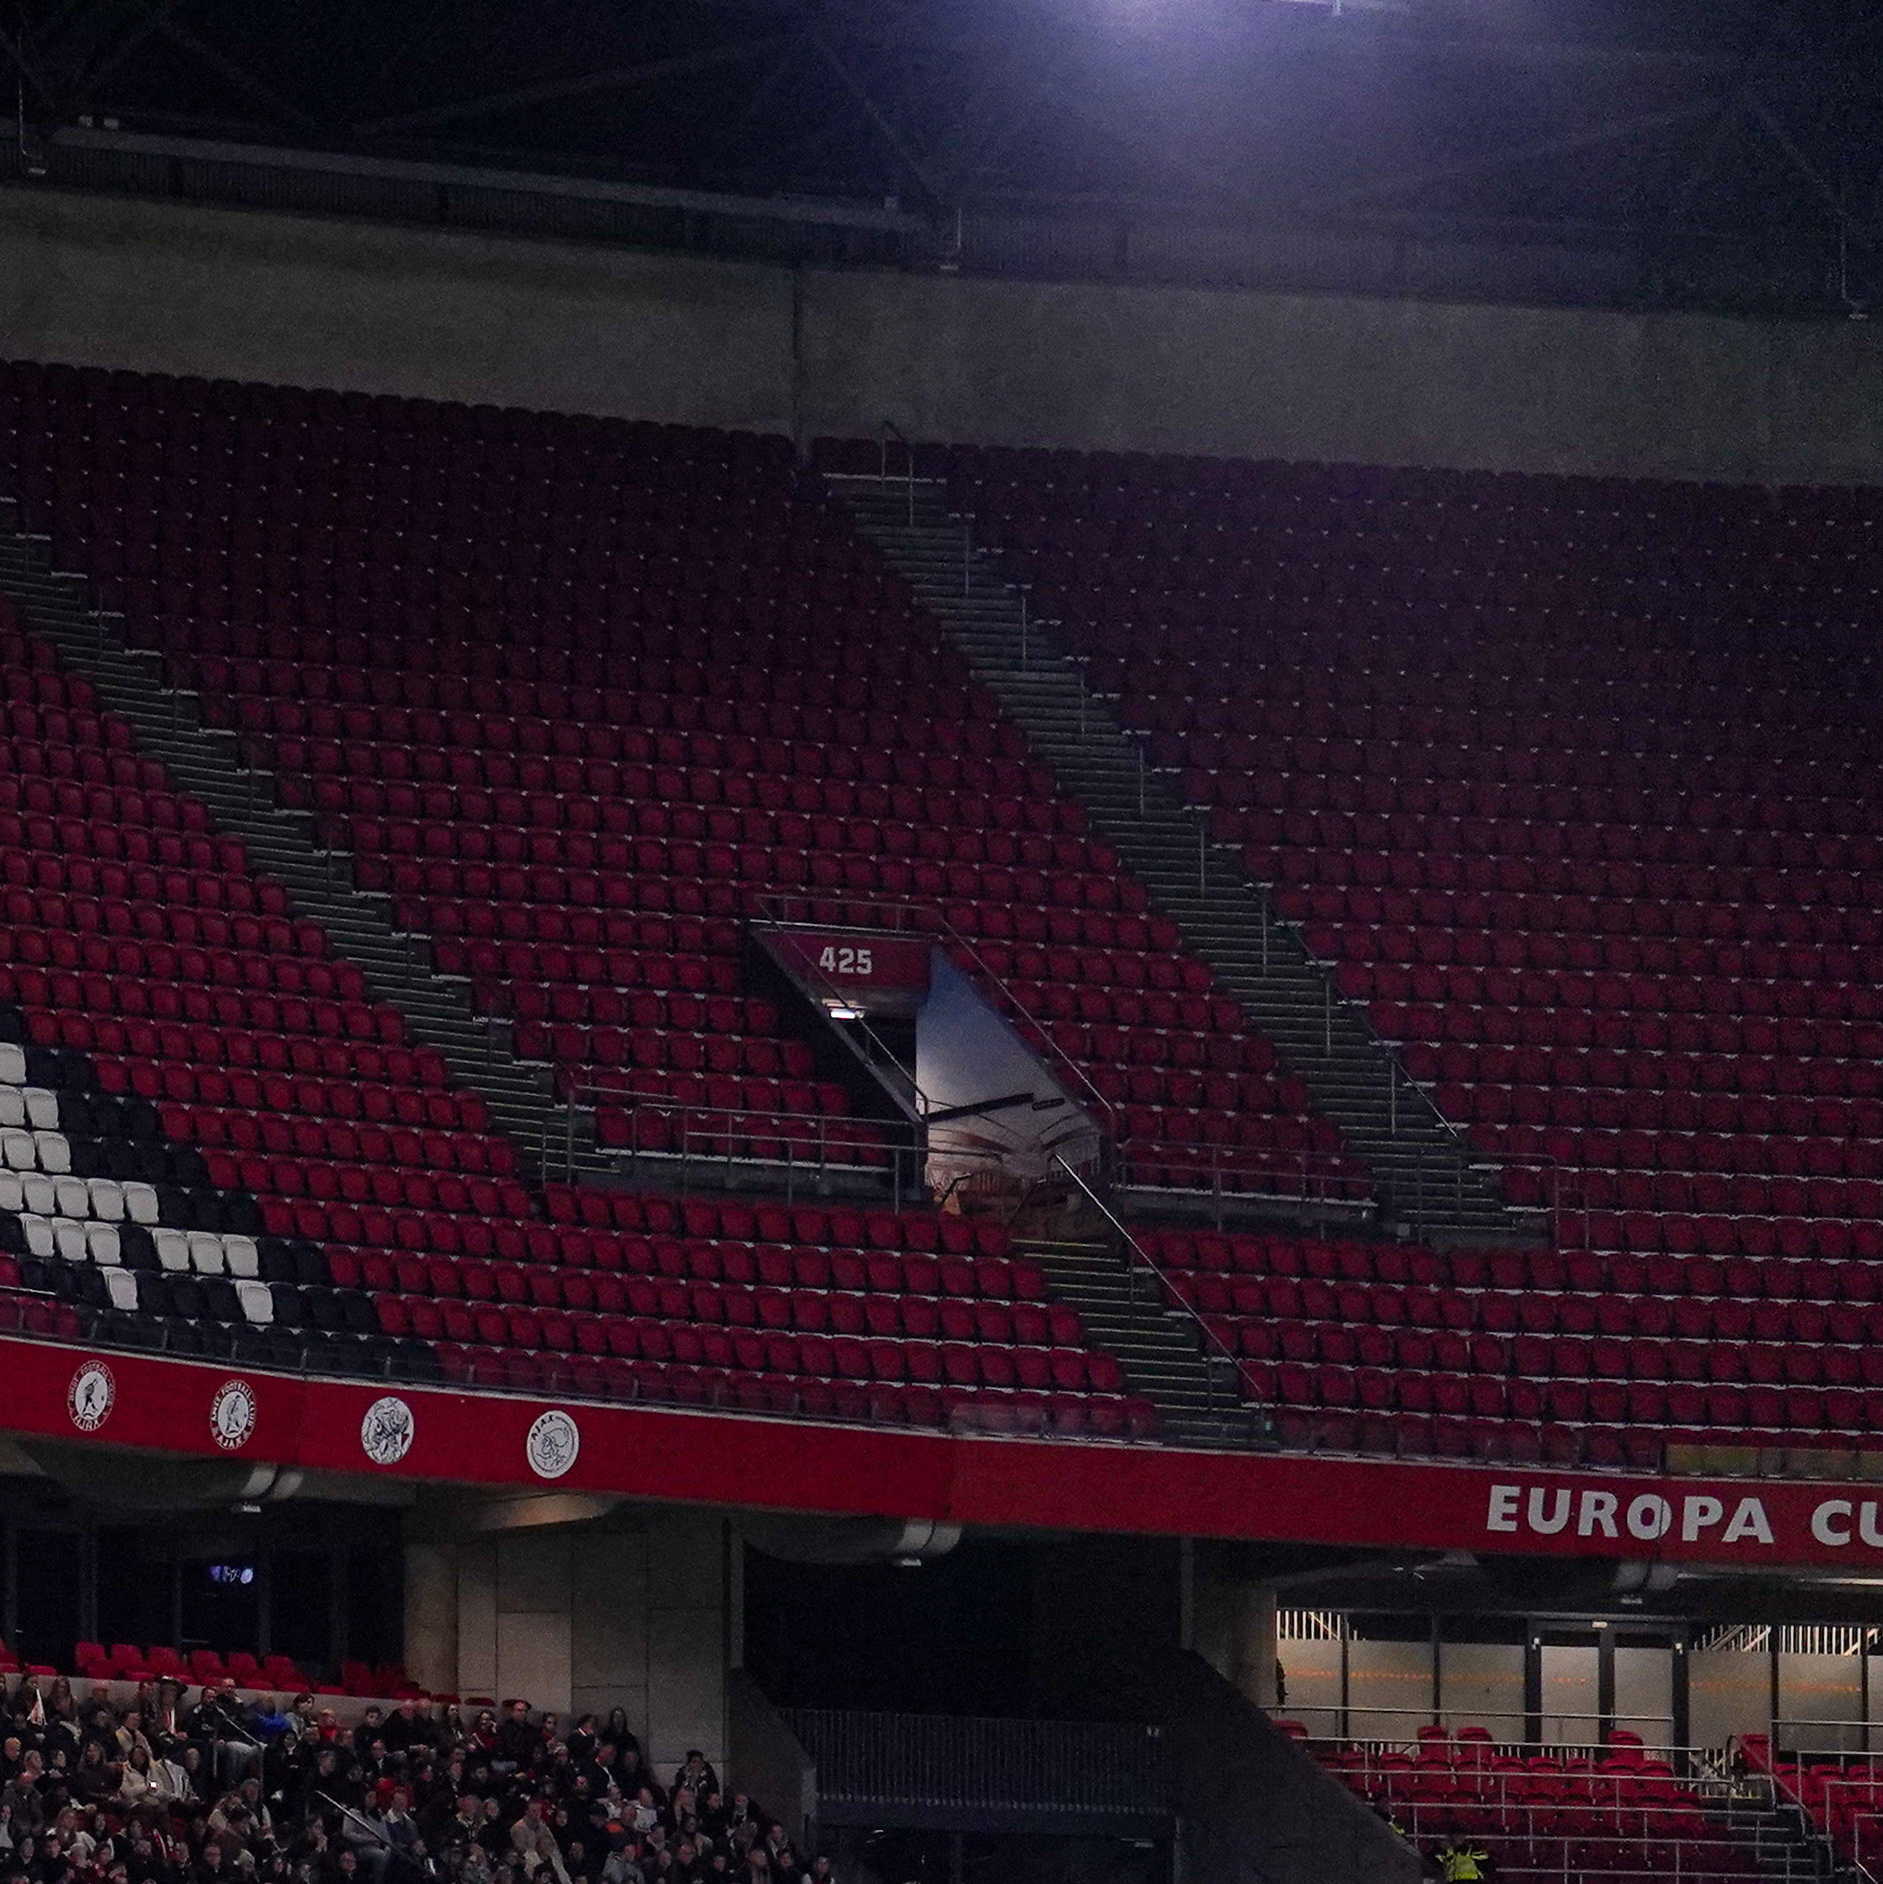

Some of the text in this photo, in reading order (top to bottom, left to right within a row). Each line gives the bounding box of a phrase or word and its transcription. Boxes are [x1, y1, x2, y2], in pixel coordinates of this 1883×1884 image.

[820, 947, 871, 974] 425
[531, 1415, 554, 1441] AJAX
[1488, 1486, 1773, 1543] EUROPA
